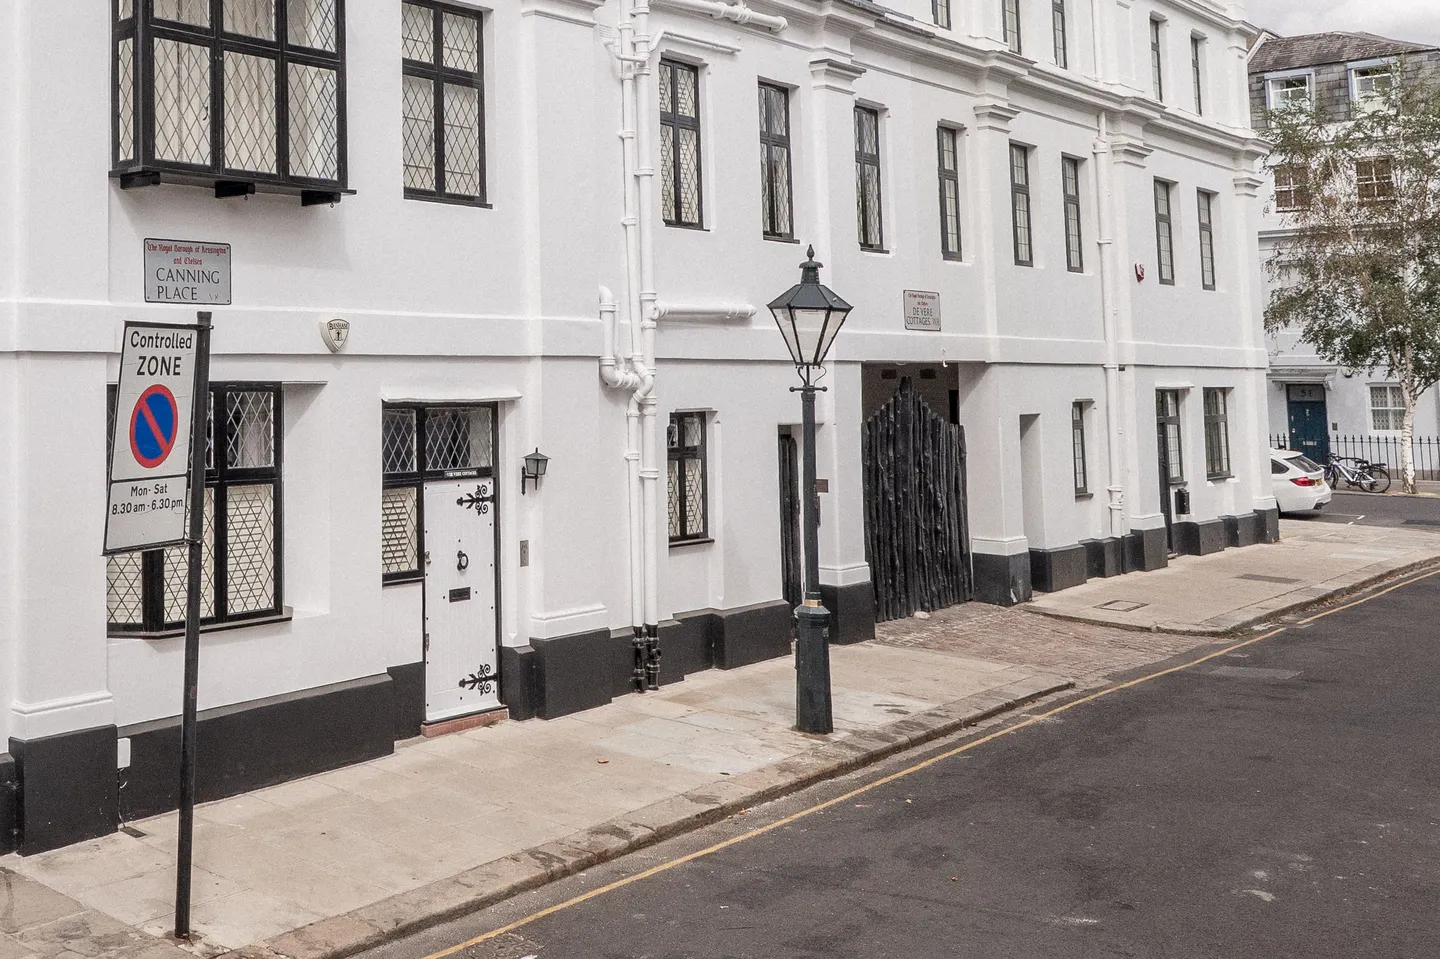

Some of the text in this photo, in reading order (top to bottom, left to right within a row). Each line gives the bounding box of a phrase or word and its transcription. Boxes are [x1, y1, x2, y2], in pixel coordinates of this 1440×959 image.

[195, 245, 200, 253] of
[156, 267, 220, 284] CANNING
[157, 285, 198, 301] PLACE
[913, 307, 933, 317] DE VERE
[130, 330, 193, 350] Controlled
[136, 355, 181, 376] ZONE
[153, 483, 168, 495] Sat
[112, 503, 132, 516] 8.30
[133, 504, 146, 512] am
[151, 498, 170, 511] 6.30
[171, 499, 184, 511] pm
